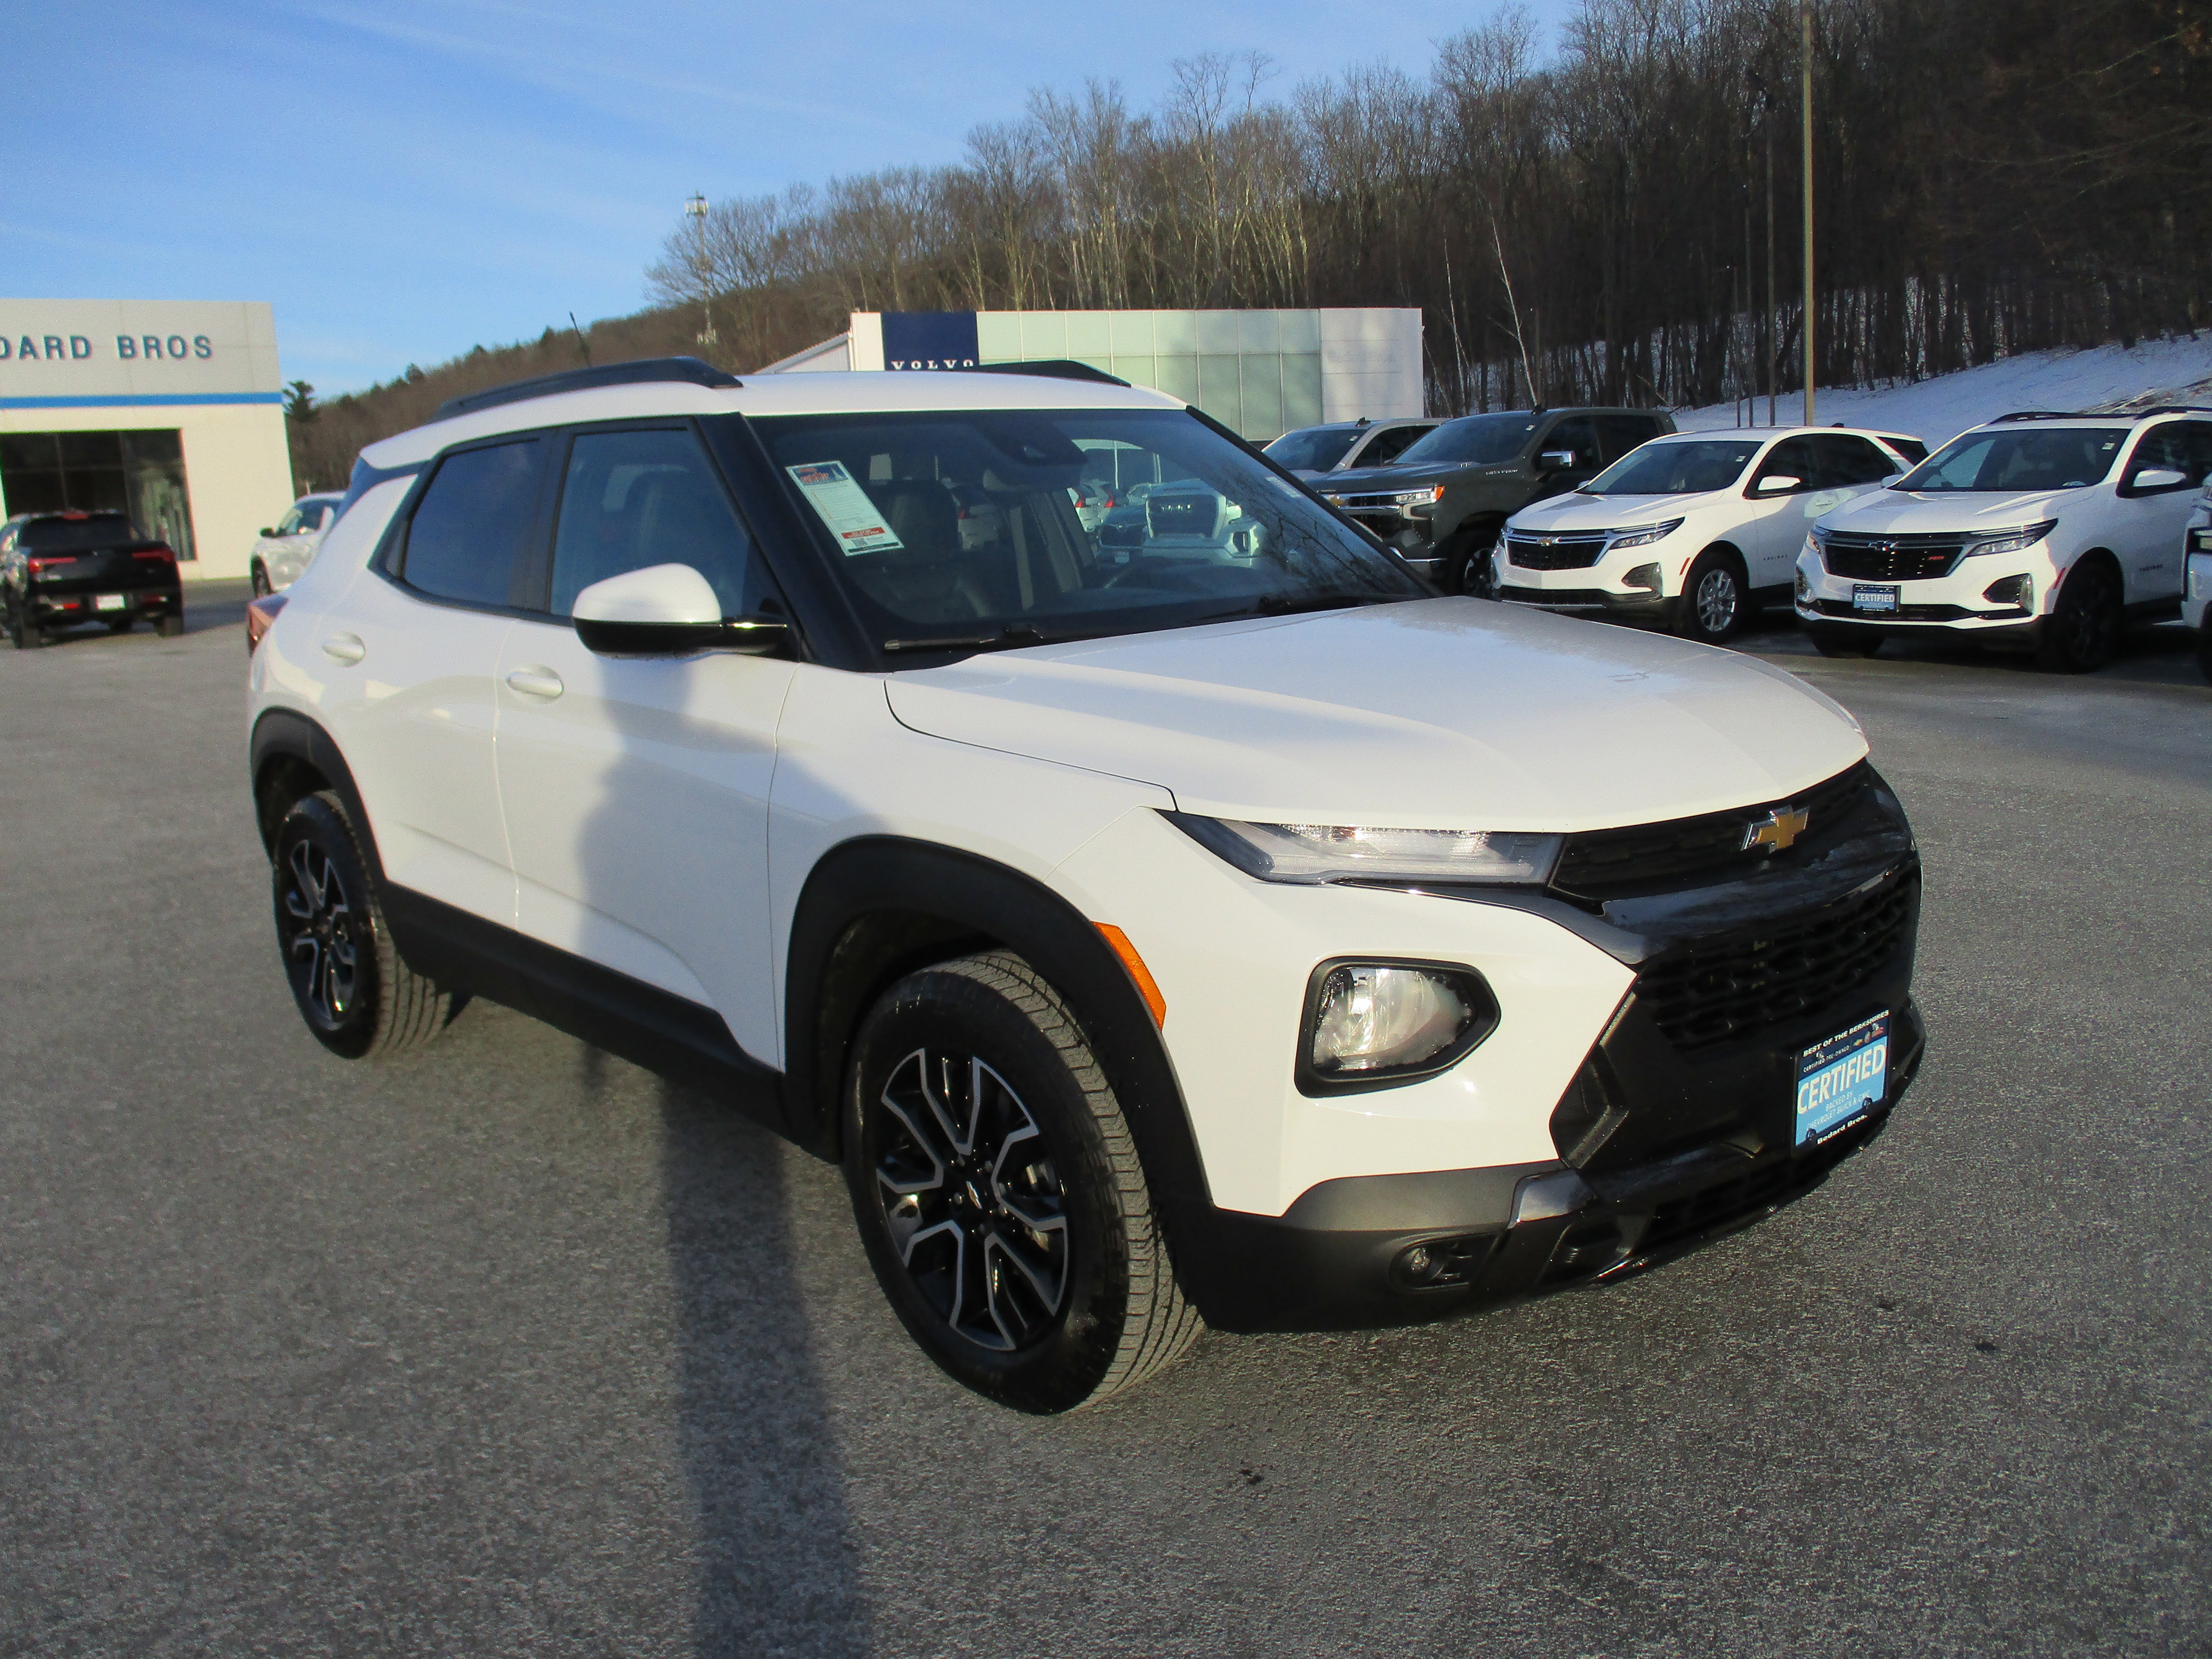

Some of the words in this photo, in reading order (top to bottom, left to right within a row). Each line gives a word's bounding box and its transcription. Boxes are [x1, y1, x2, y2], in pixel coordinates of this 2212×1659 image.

[115, 334, 213, 360] BROS
[891, 359, 974, 370] VOLVO
[1855, 594, 1894, 602] CERTIFIED
[1803, 1043, 1822, 1057] BEST
[1823, 1037, 1833, 1047] OF
[1834, 1030, 1848, 1042] THE
[1849, 1009, 1890, 1035] BERKSHIRES
[1797, 1044, 1887, 1115] CERTIFIED
[1817, 1124, 1846, 1145] Bedard
[1847, 1115, 1868, 1127] Bros.
